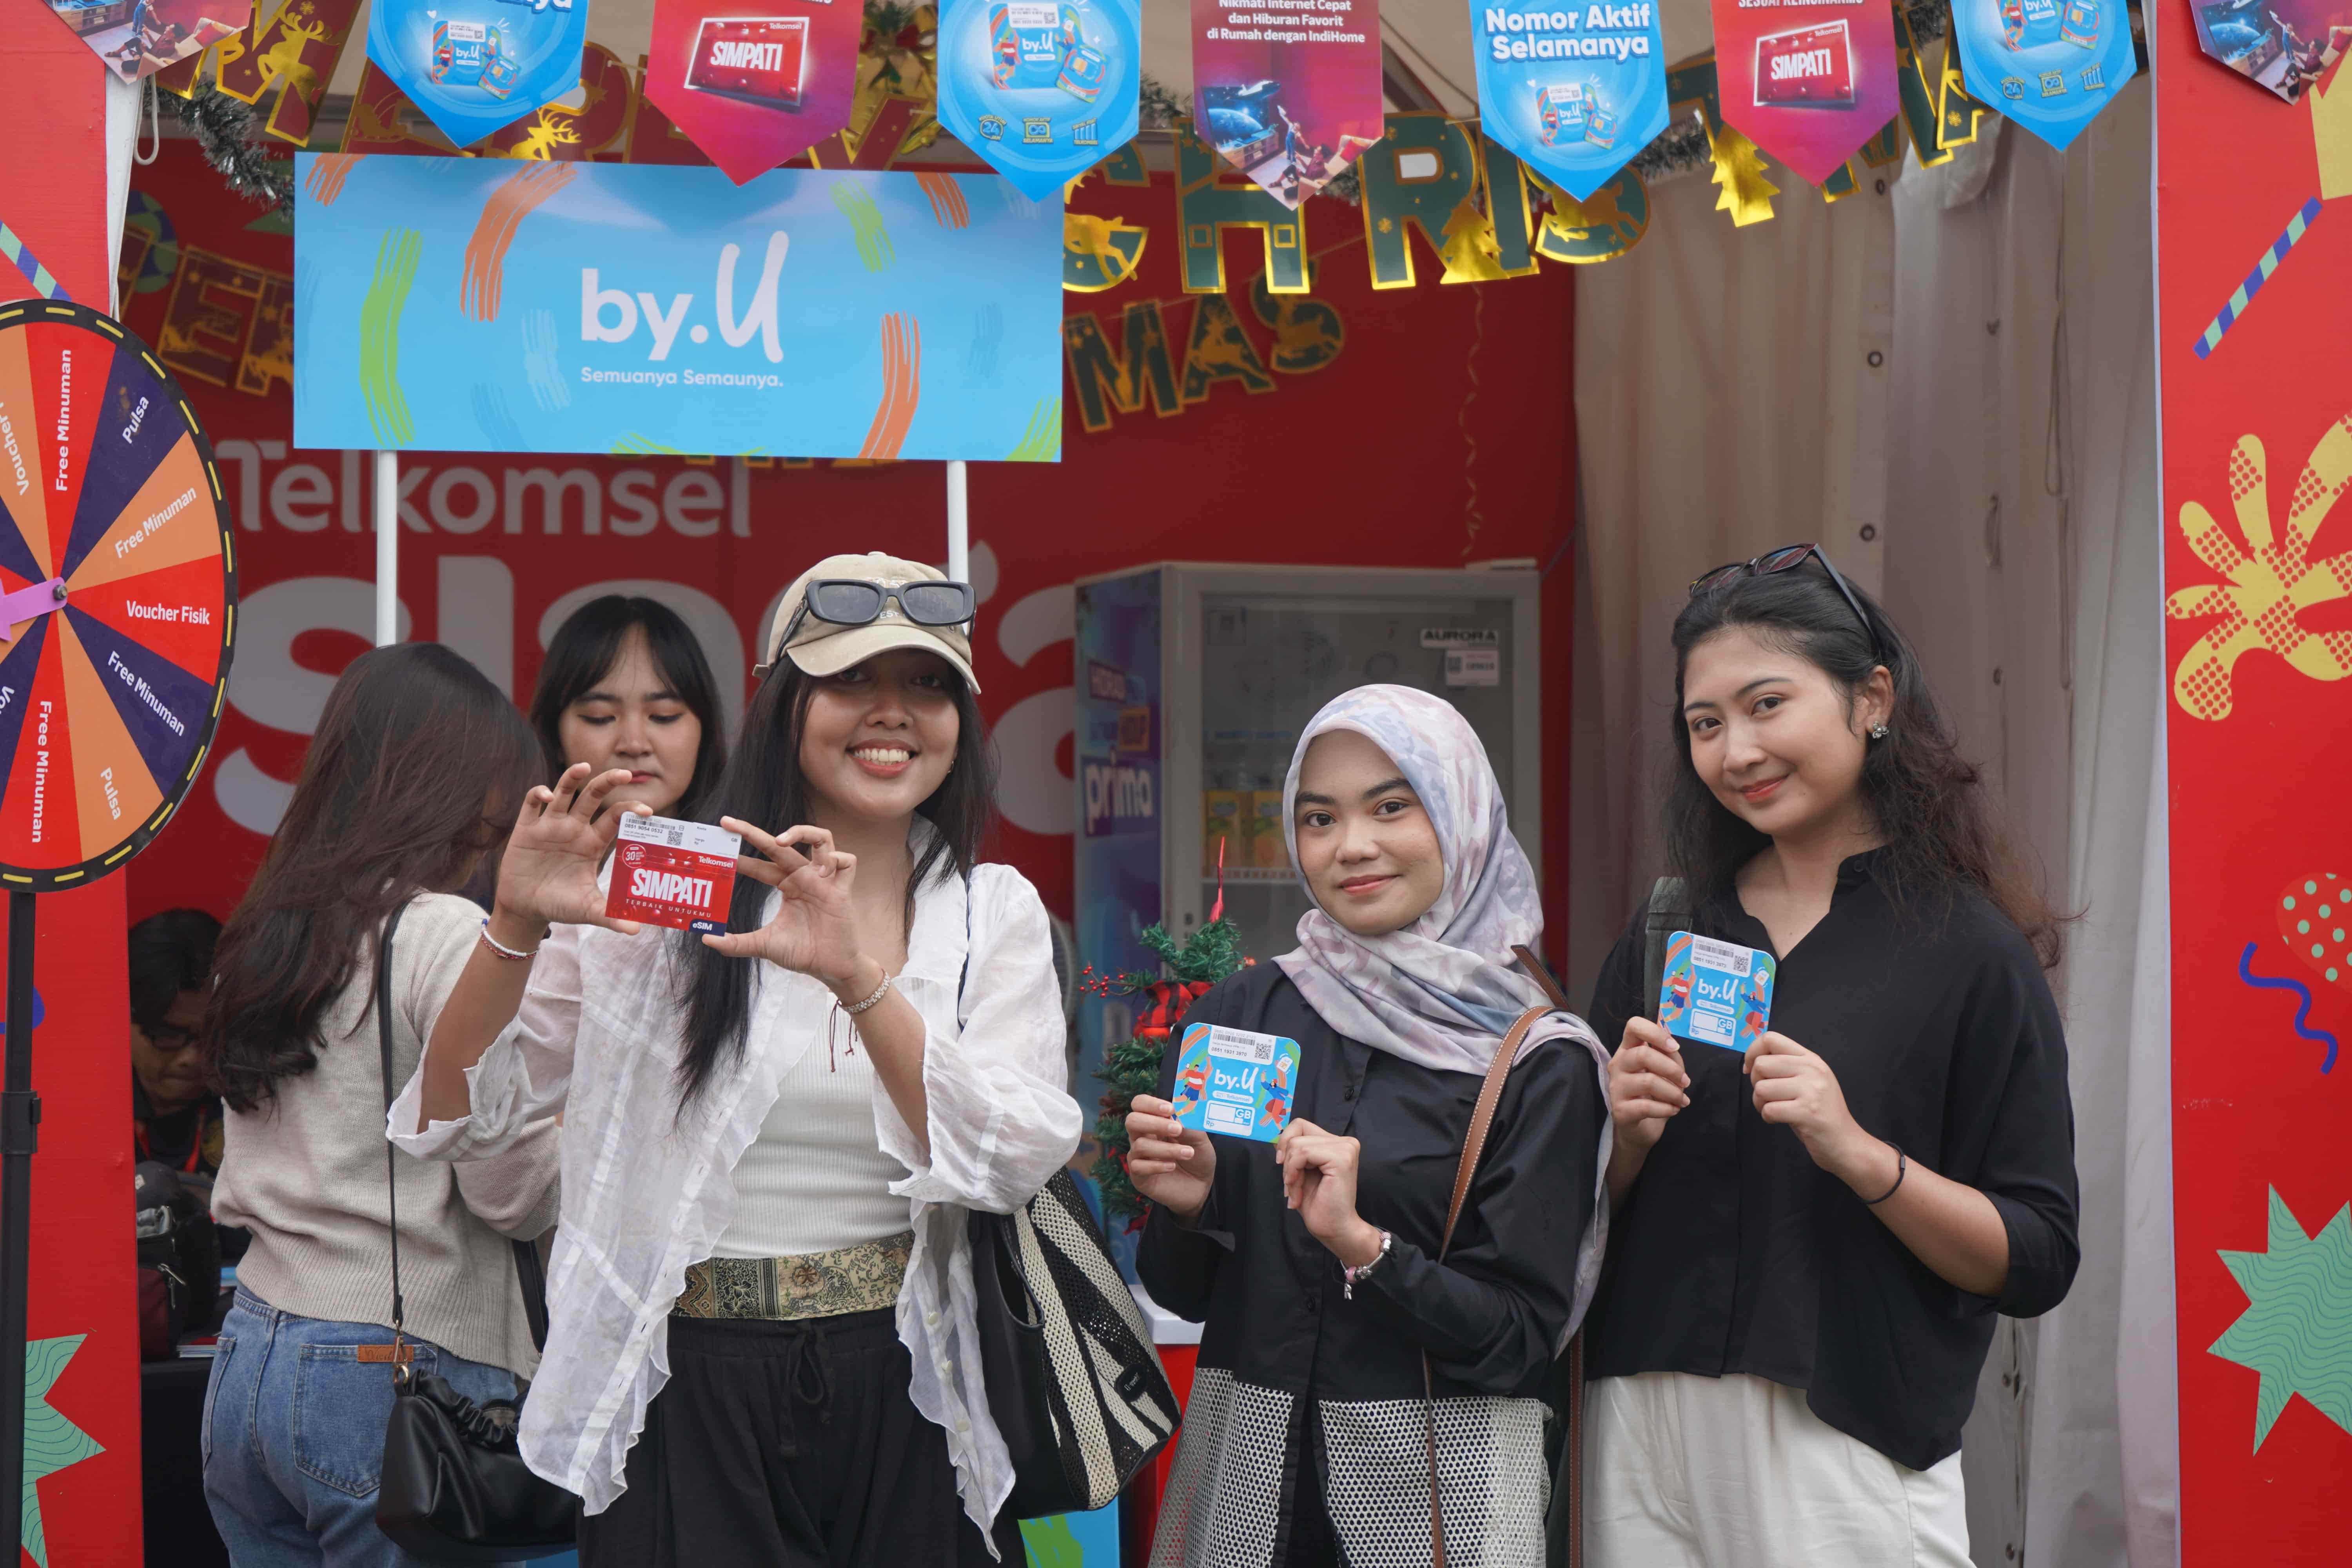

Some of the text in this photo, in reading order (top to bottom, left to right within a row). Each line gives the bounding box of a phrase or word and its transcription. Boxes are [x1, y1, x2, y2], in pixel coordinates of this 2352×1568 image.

[1268, 0, 1316, 10] Internet
[1317, 0, 1351, 12] Cepat
[1485, 3, 1650, 34] Nomor Aktif
[1229, 13, 1343, 26] dan Hiburan Favorit
[1022, 31, 1054, 53] by.U
[1207, 28, 1365, 43] di Rumah dengan IndiHome
[1492, 34, 1650, 62] Selamanya
[456, 44, 480, 60] by.U
[710, 41, 783, 71] SIMPATI
[1771, 48, 1832, 80] SIMPATI
[983, 122, 1000, 135] 24
[581, 230, 789, 363] by.U
[581, 367, 784, 389] Semuanya Semaunya.
[56, 349, 71, 491] Free Minuman
[122, 396, 149, 445] Pulsa
[114, 487, 197, 558] Free Minuman
[126, 600, 211, 625] Voucher Fisik
[1423, 630, 1496, 642] AURORA
[108, 651, 185, 737] Free Minuman
[32, 700, 52, 843] Free Minuman
[100, 767, 122, 820] Pulsa
[1085, 747, 1153, 835] prima
[626, 851, 635, 861] 30
[698, 856, 734, 868] Telkomsel
[631, 868, 713, 908] SIMPATI
[626, 899, 711, 918] TERBAIK UNTUKMU
[692, 922, 713, 931] eSIM
[1698, 978, 1739, 1004] by.U
[1718, 1019, 1732, 1029] GB
[1214, 1067, 1259, 1094] by.U
[1235, 1109, 1252, 1119] GB
